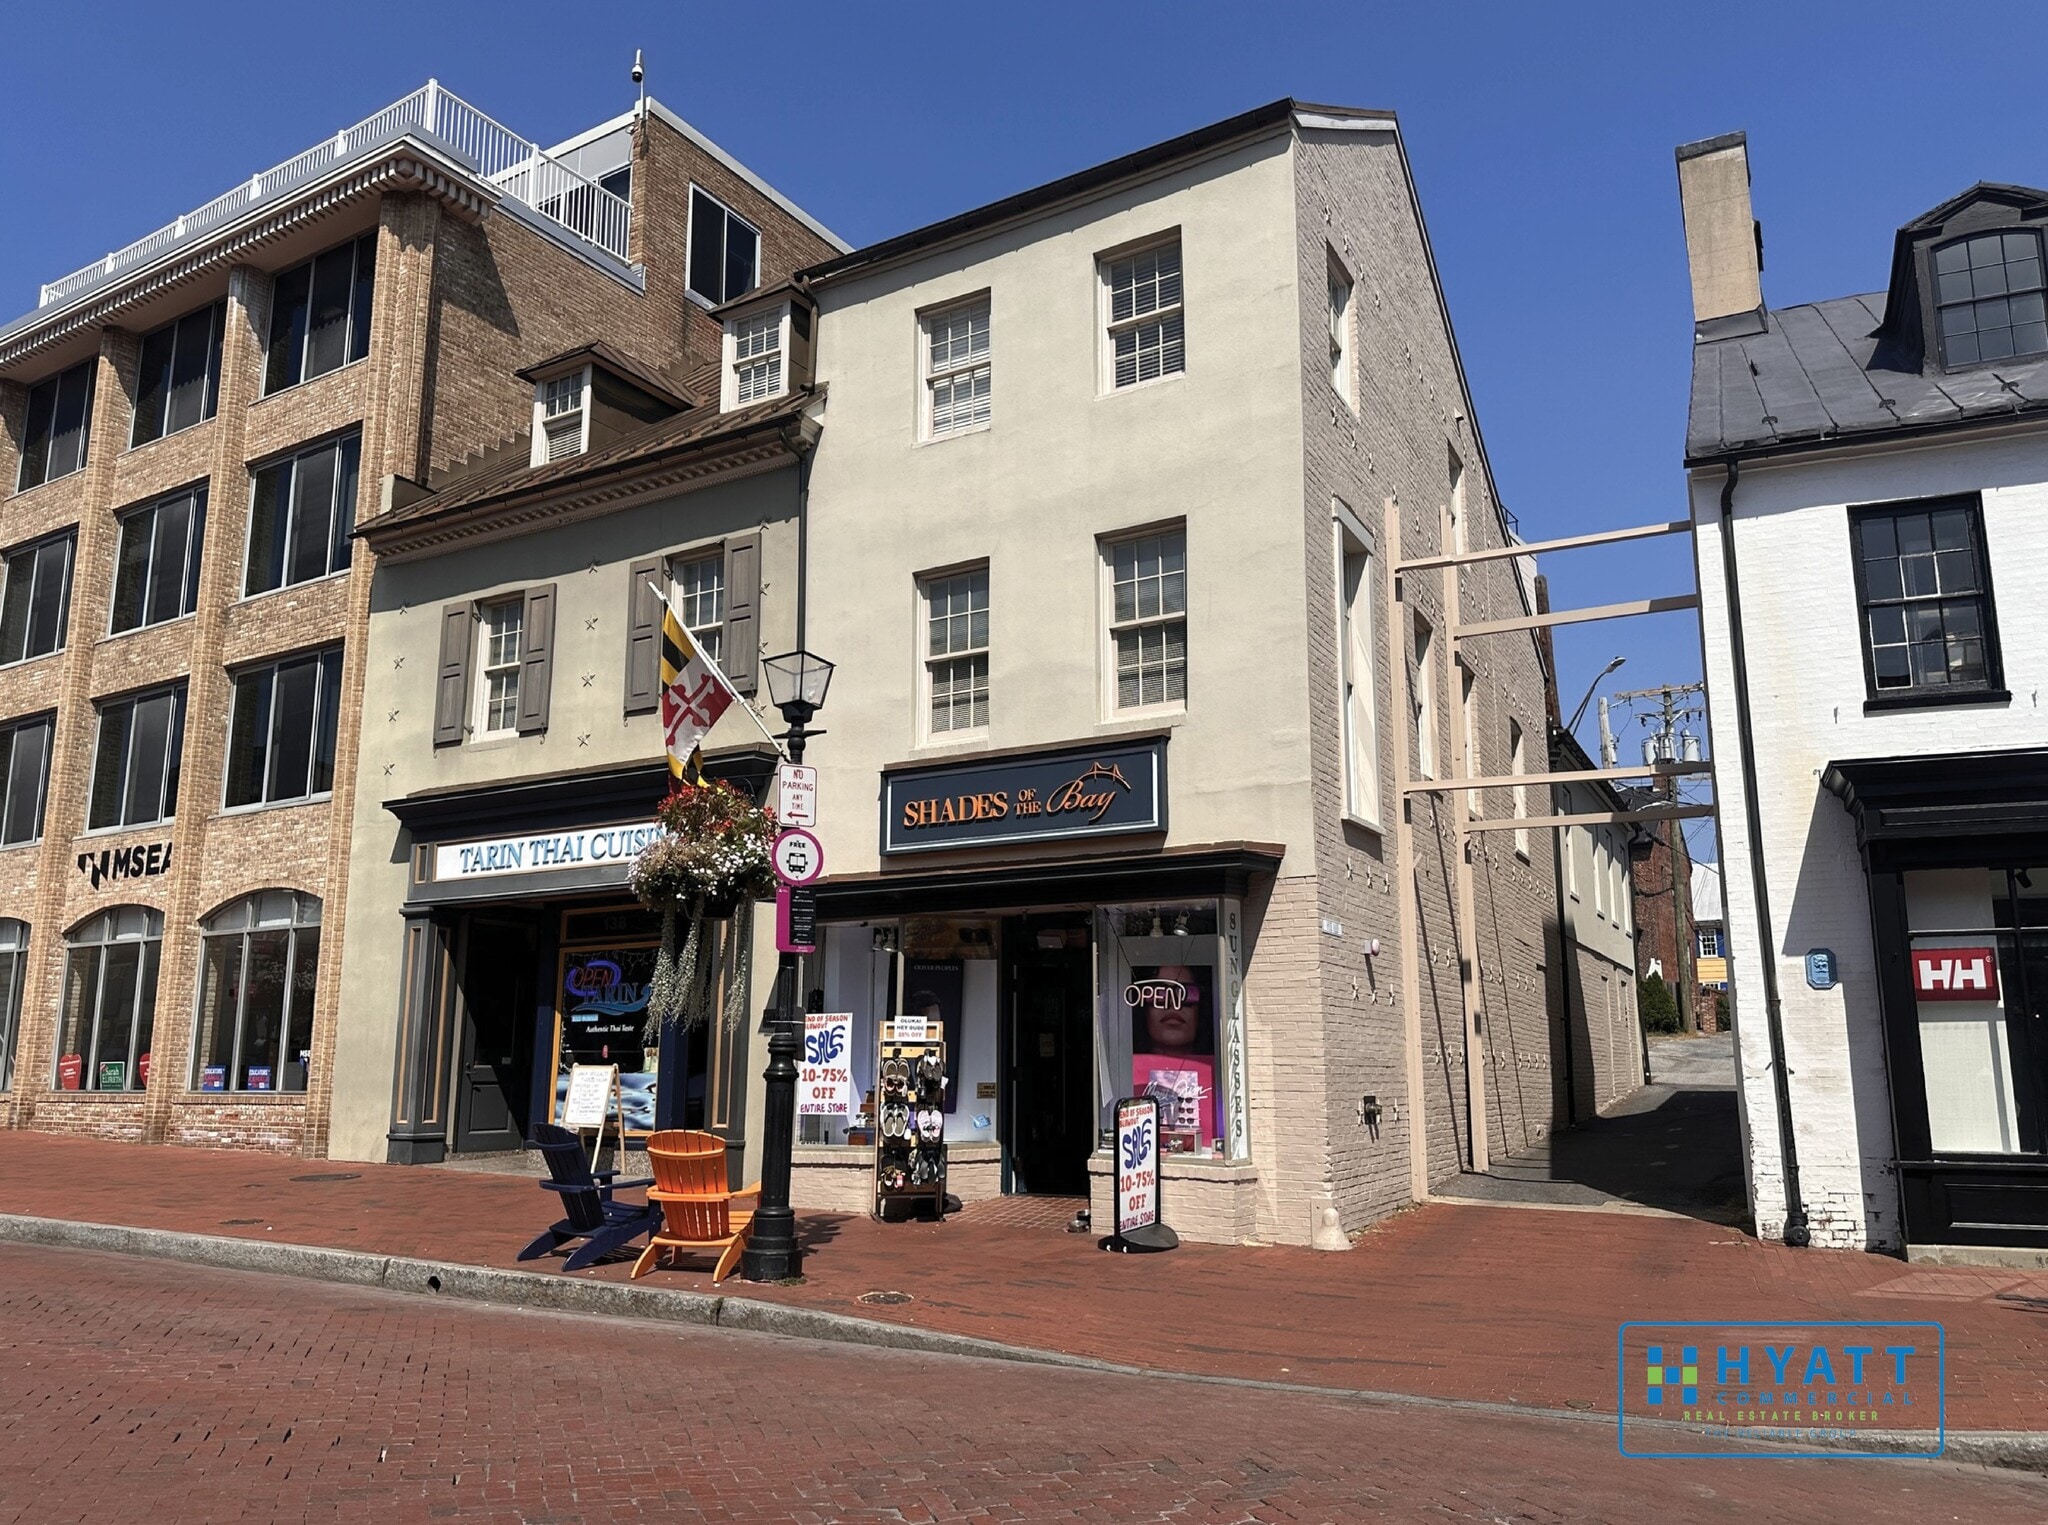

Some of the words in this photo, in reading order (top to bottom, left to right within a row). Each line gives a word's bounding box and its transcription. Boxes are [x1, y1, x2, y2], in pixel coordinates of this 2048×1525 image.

[793, 769, 804, 779] NO
[782, 781, 814, 792] PARKING
[1018, 788, 1036, 801] OF
[791, 803, 804, 811] TIME
[1013, 801, 1042, 816] THE
[1046, 780, 1117, 822] Bay
[903, 792, 1008, 827] SHADES
[789, 841, 806, 849] FREE
[460, 843, 525, 873] TARIN
[529, 835, 585, 866] THAI
[573, 968, 613, 988] OPEN
[582, 983, 639, 1004] TARIN
[1123, 984, 1182, 1010] OPEN
[804, 1022, 828, 1030] LOWOUT
[825, 1014, 848, 1023] SEASON
[1229, 912, 1242, 1138] SUNGLASSES
[585, 1025, 609, 1033] Authentic
[806, 1025, 846, 1065] SALE
[801, 1068, 848, 1083] 10-75%
[812, 1086, 836, 1099] OFF
[800, 1103, 825, 1113] ENTIRE
[827, 1102, 848, 1113] STORE
[1122, 1118, 1152, 1170] SALE
[1120, 1169, 1154, 1193] 10-75%
[1129, 1193, 1147, 1211] OFF
[1140, 1209, 1154, 1226] STORE
